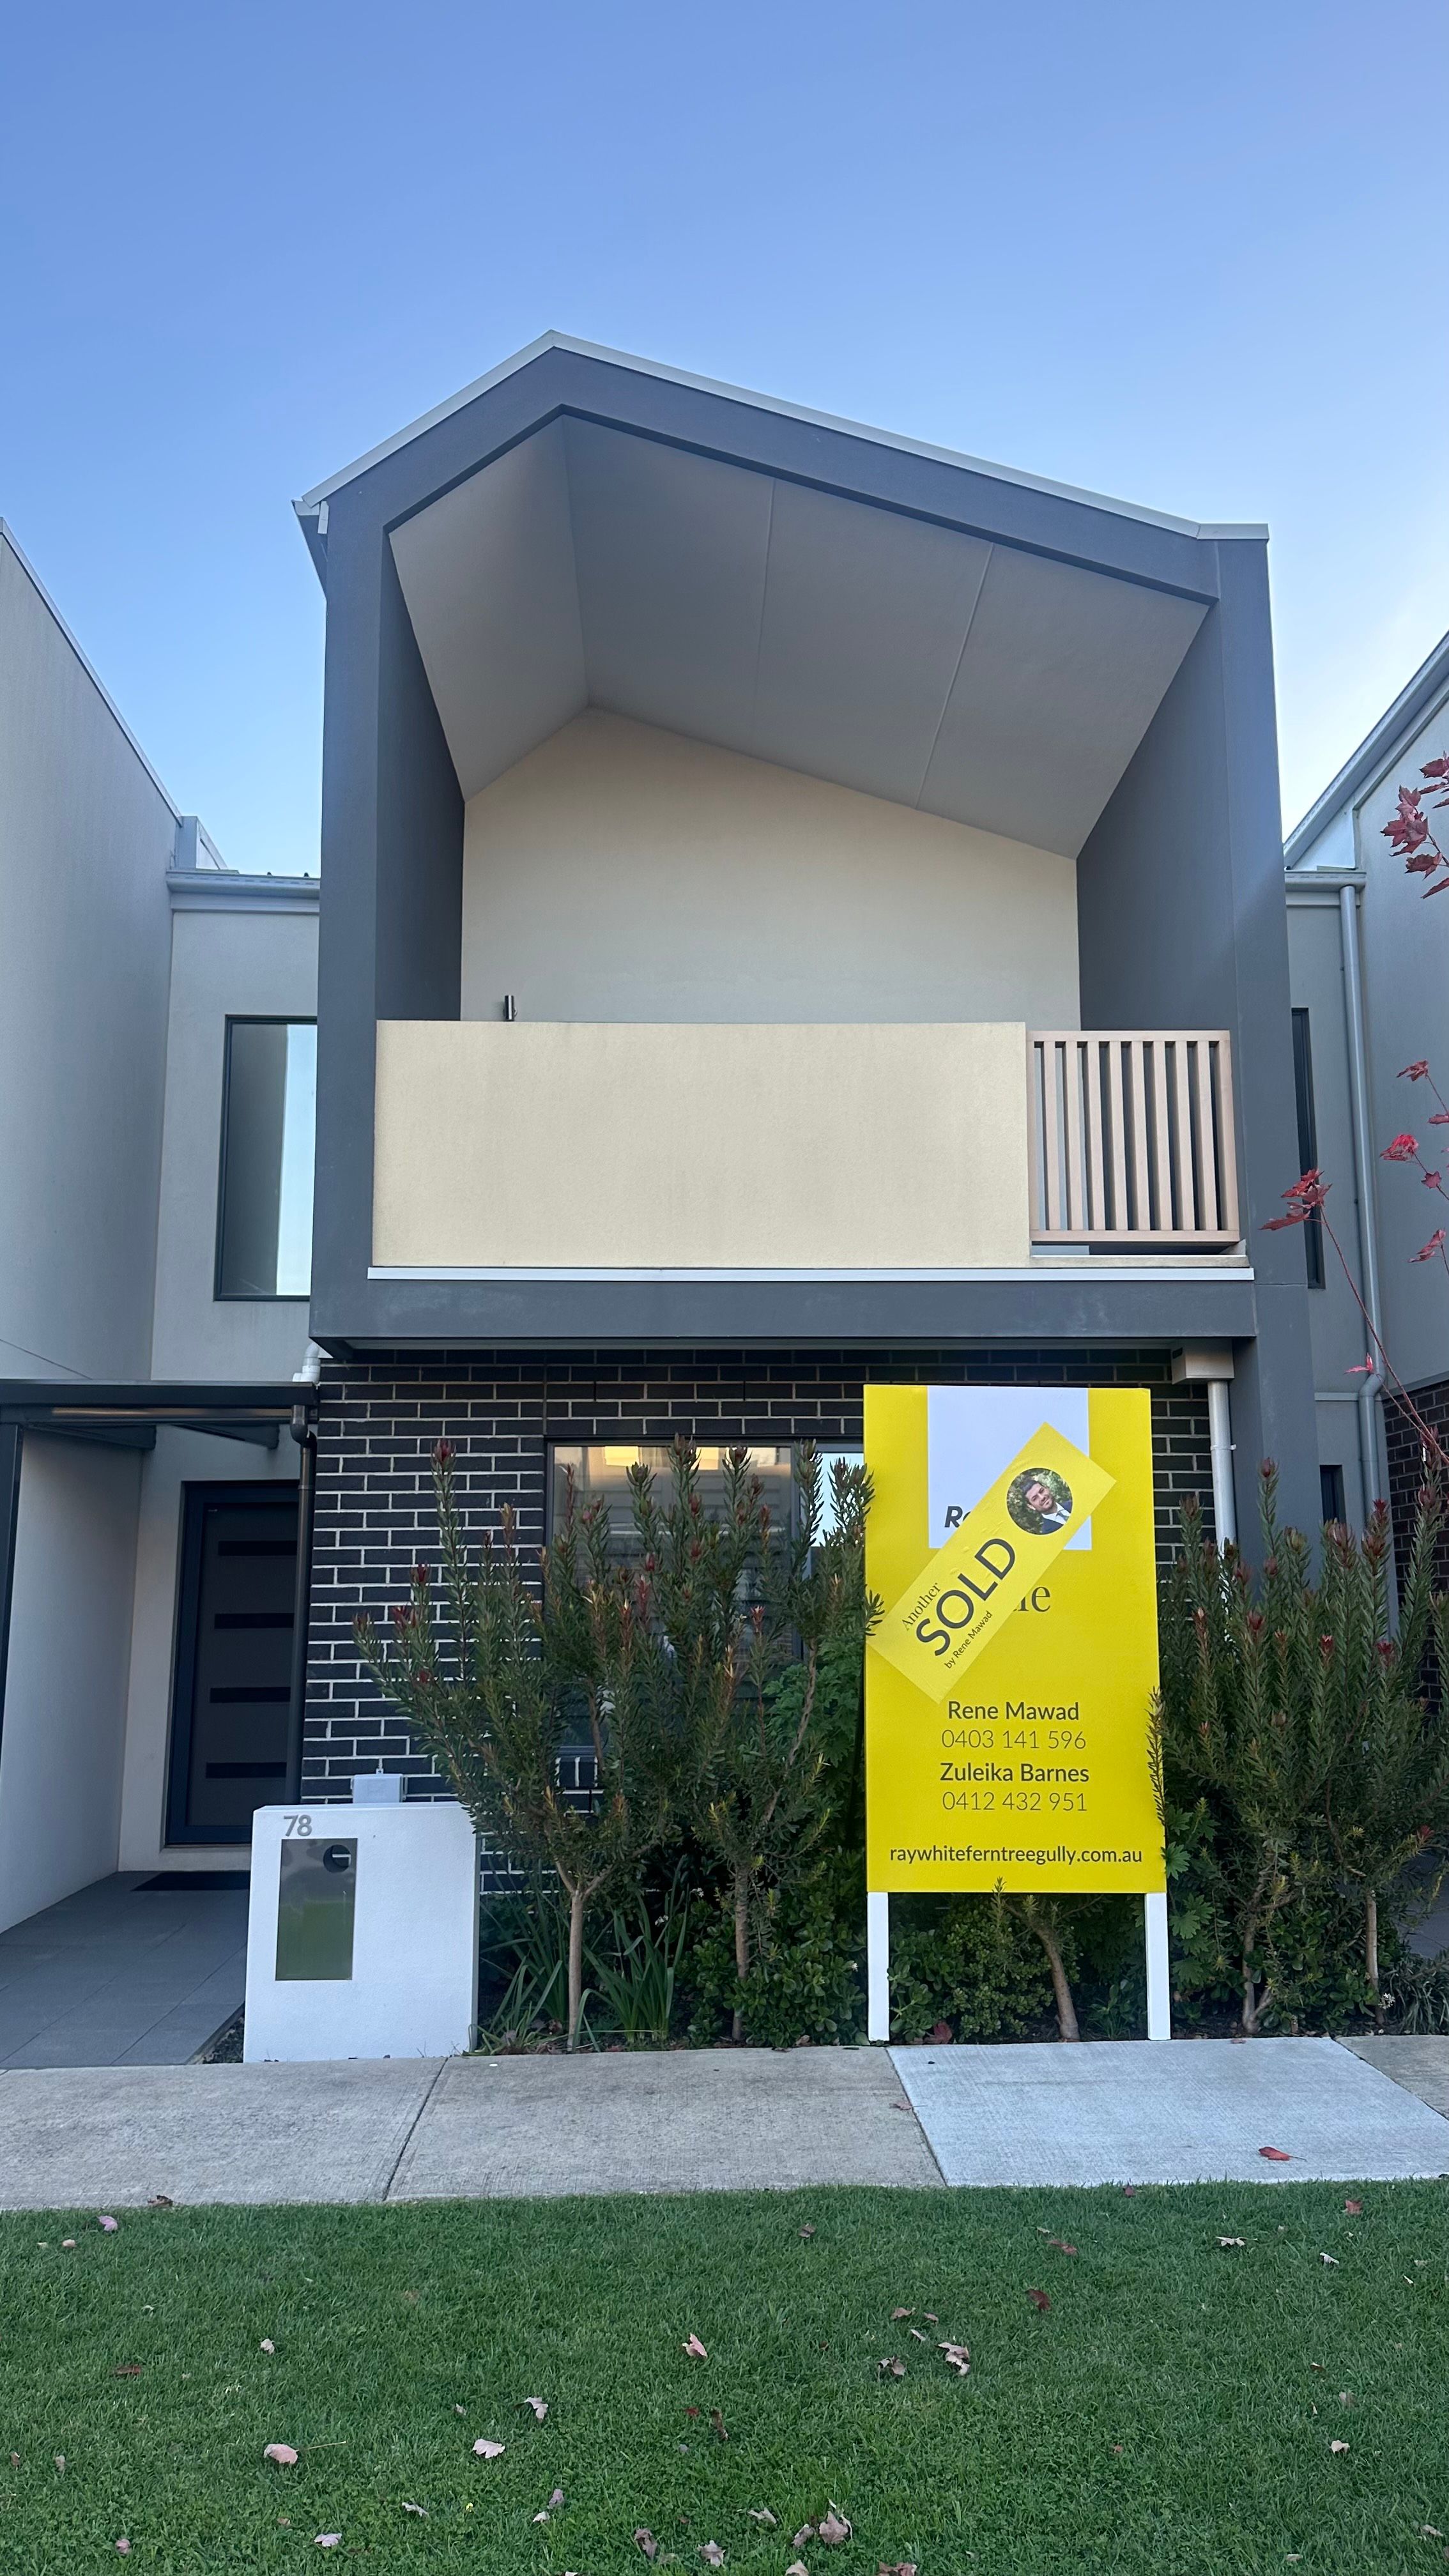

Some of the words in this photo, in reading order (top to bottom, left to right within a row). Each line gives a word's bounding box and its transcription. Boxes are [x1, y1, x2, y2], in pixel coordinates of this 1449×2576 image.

[901, 1582, 941, 1630] Another
[916, 1538, 1015, 1656] SOLD
[944, 1657, 956, 1669] by
[953, 1638, 971, 1659] Rene
[968, 1610, 993, 1639] Mawad
[948, 1701, 999, 1720] Rene
[1006, 1701, 1079, 1721] Mawad
[941, 1729, 994, 1749] 0403
[1002, 1730, 1039, 1749] 141
[1048, 1730, 1086, 1749] 596
[940, 1762, 1013, 1782] Zuleika
[1020, 1763, 1089, 1782] Barnes
[942, 1791, 995, 1811] 0412
[1002, 1792, 1041, 1811] 432
[1049, 1792, 1087, 1811] 951
[284, 1814, 312, 1837] 78
[890, 1844, 1142, 1865] raywhiteferntreegully.com.au
